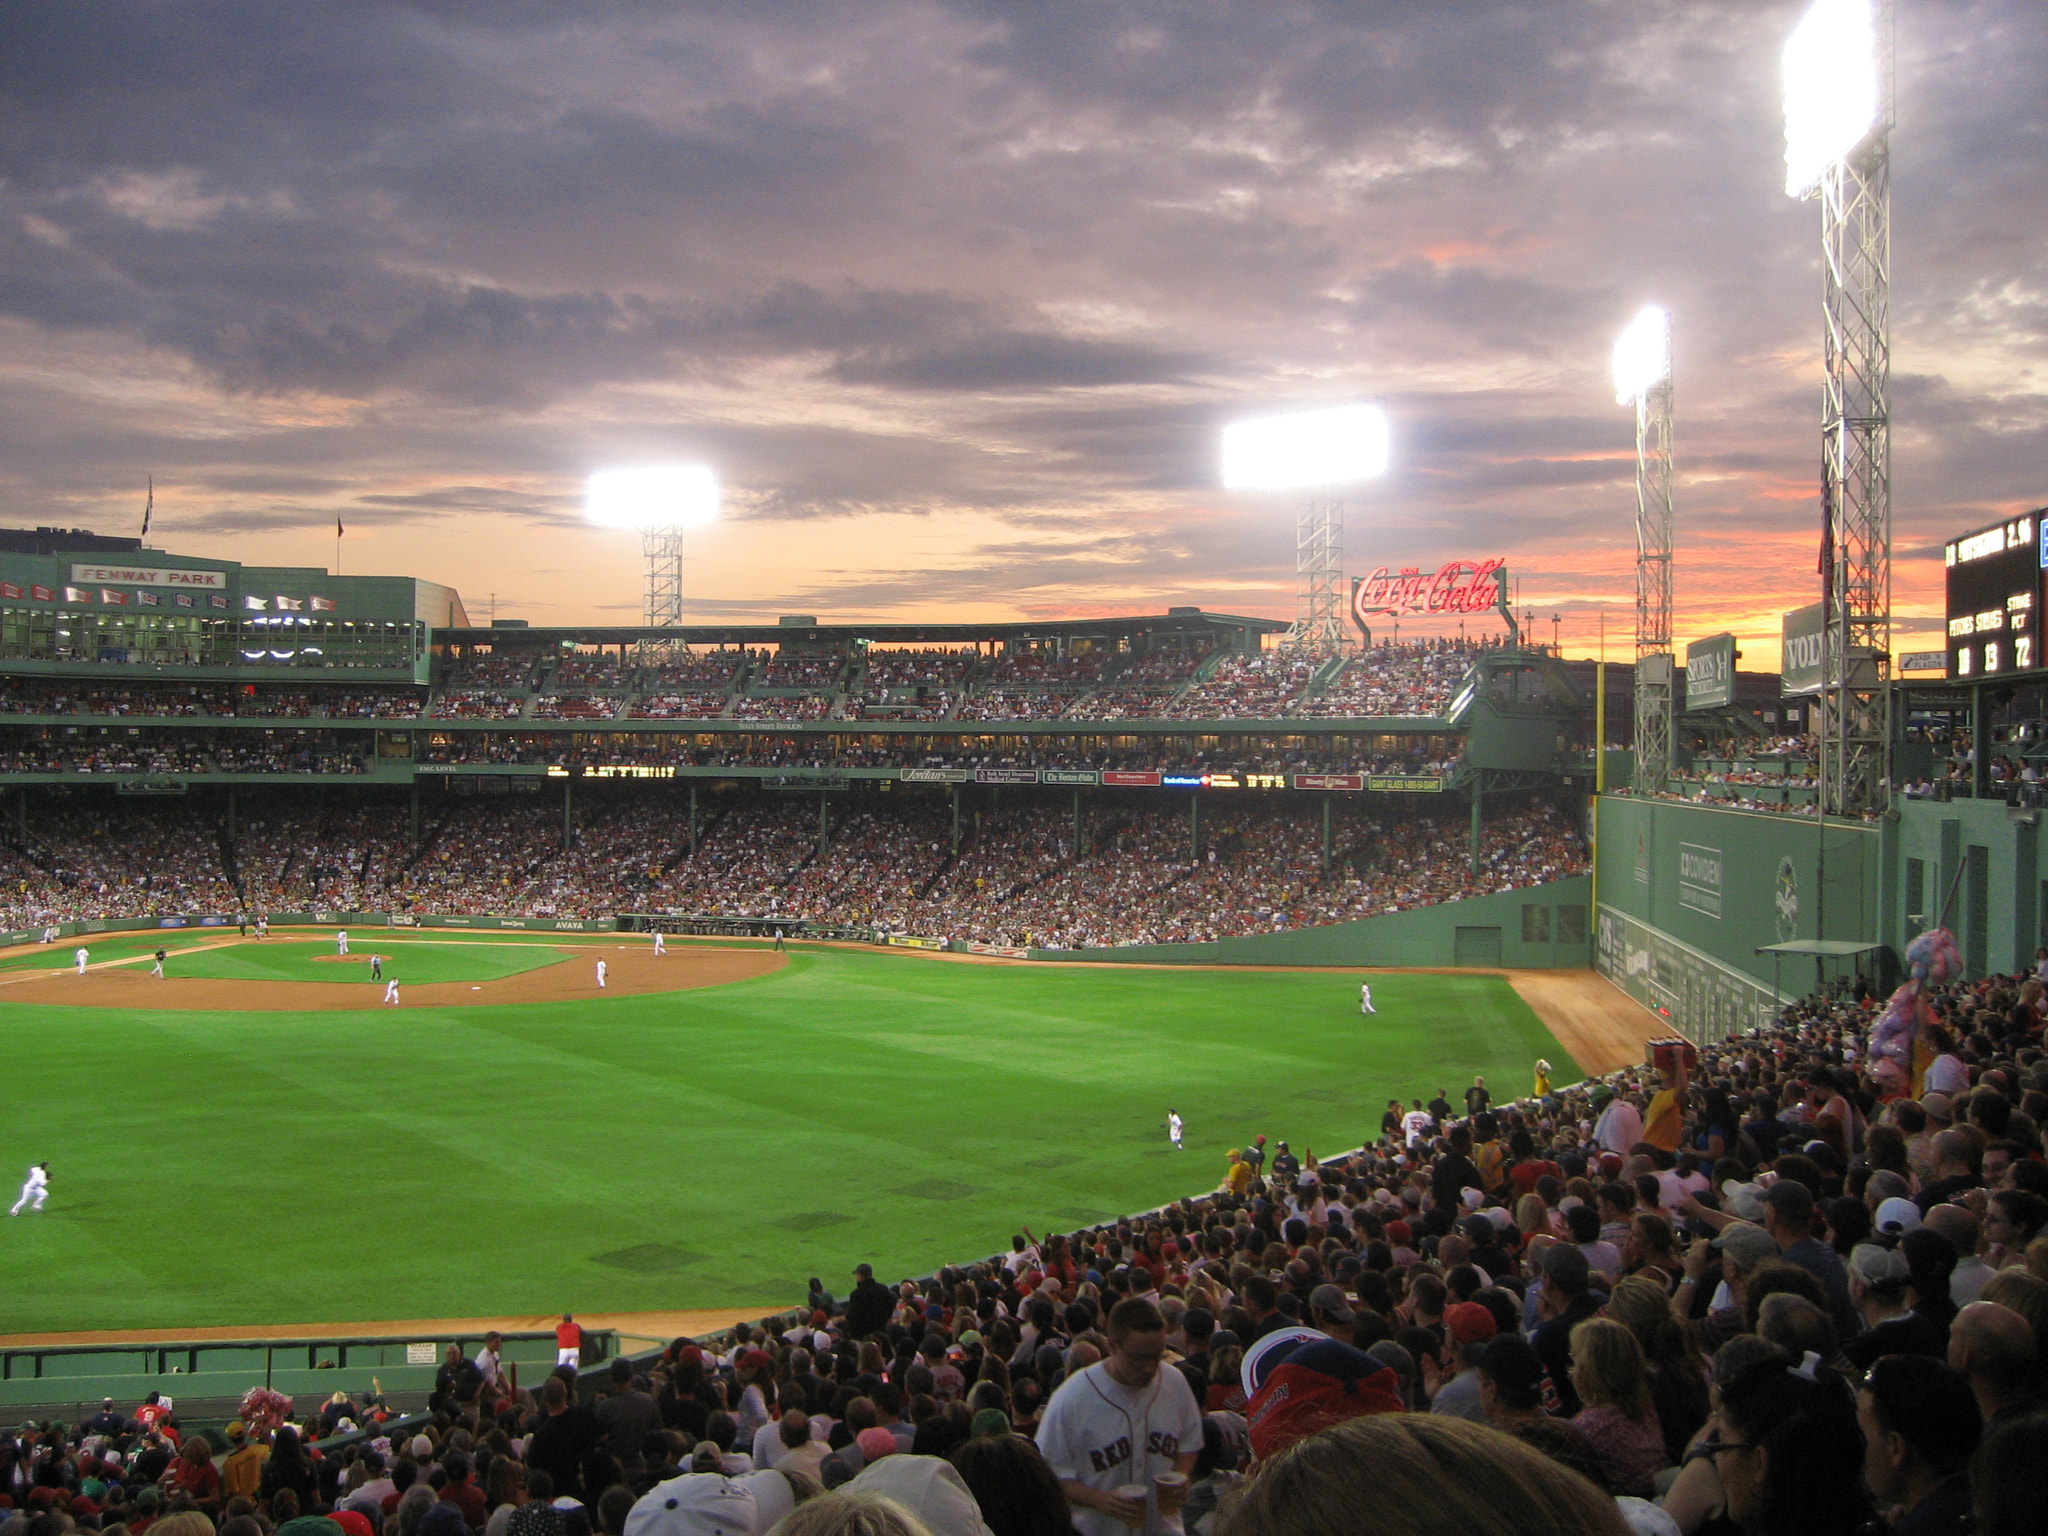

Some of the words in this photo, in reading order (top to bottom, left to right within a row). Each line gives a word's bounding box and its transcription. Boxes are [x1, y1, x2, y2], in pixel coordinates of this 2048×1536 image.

[83, 568, 157, 582] FENWAY
[168, 573, 216, 585] PARK
[1354, 557, 1505, 617] Coca-Cola
[2011, 614, 2026, 630] PCT
[1984, 642, 1998, 672] 13
[2014, 636, 2031, 668] 72
[906, 769, 946, 780] Jordan's
[1262, 780, 1271, 788] 13
[1275, 780, 1284, 788] 72
[1387, 779, 1404, 789] GLASS
[555, 921, 584, 929] AVAYA
[1089, 1436, 1131, 1472] RED
[1146, 1431, 1179, 1459] SO
